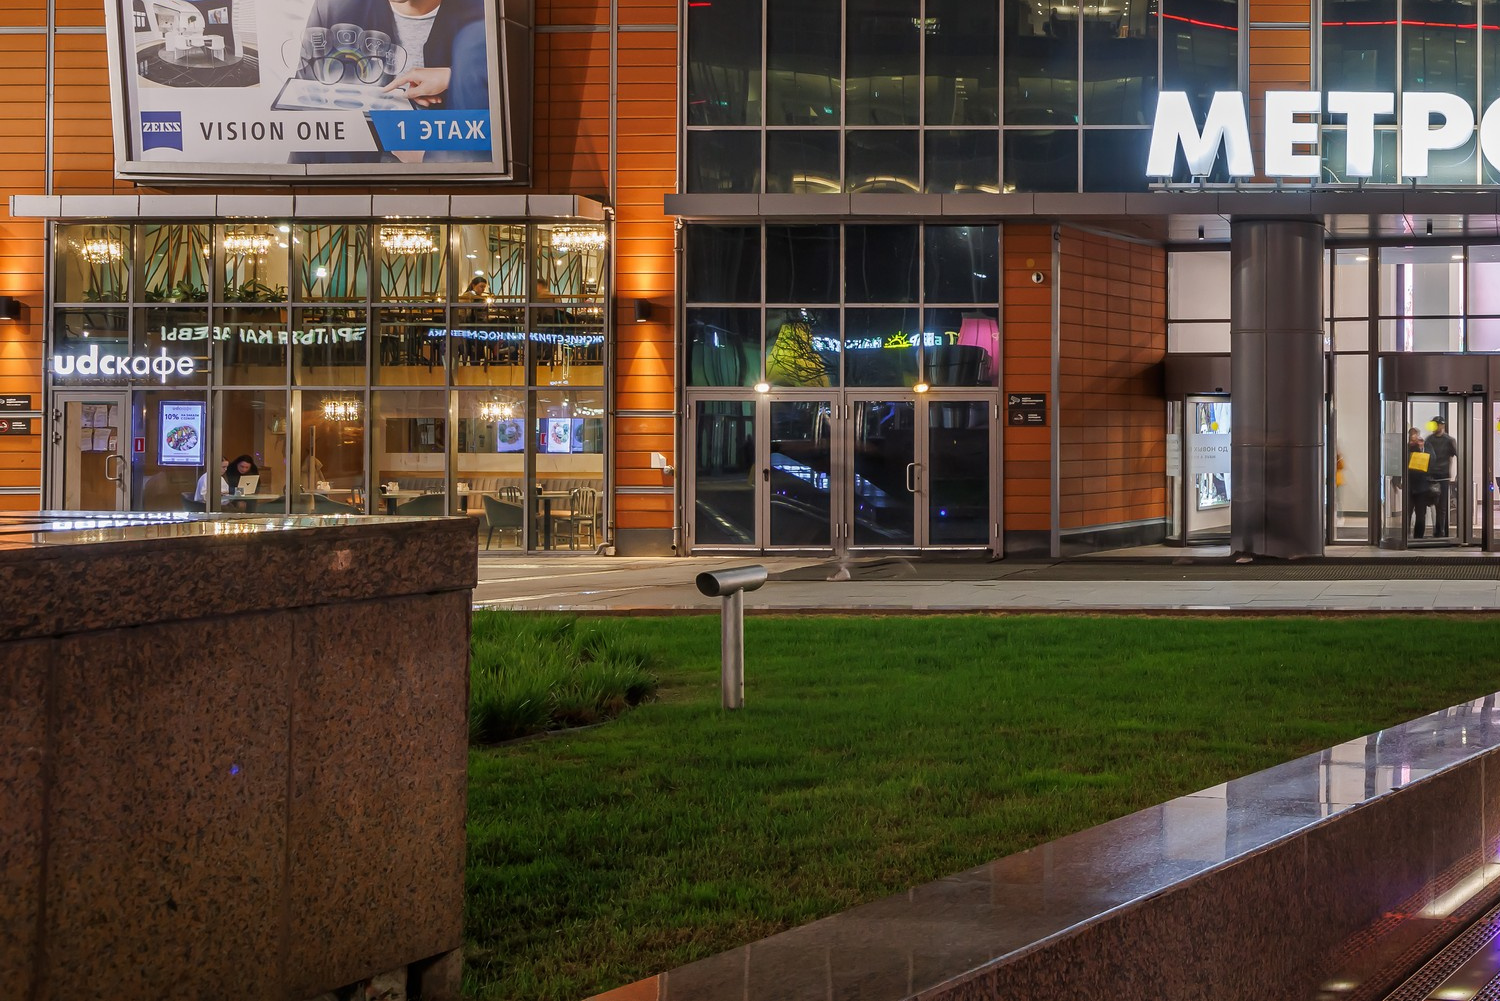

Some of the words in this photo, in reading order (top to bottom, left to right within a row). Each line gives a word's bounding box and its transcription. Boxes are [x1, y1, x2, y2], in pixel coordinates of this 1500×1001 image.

[142, 121, 181, 134] ZEISS
[200, 121, 285, 141] VISION
[297, 121, 346, 141] ONE
[397, 121, 406, 140] 1
[419, 120, 487, 141] ЭТАЖ
